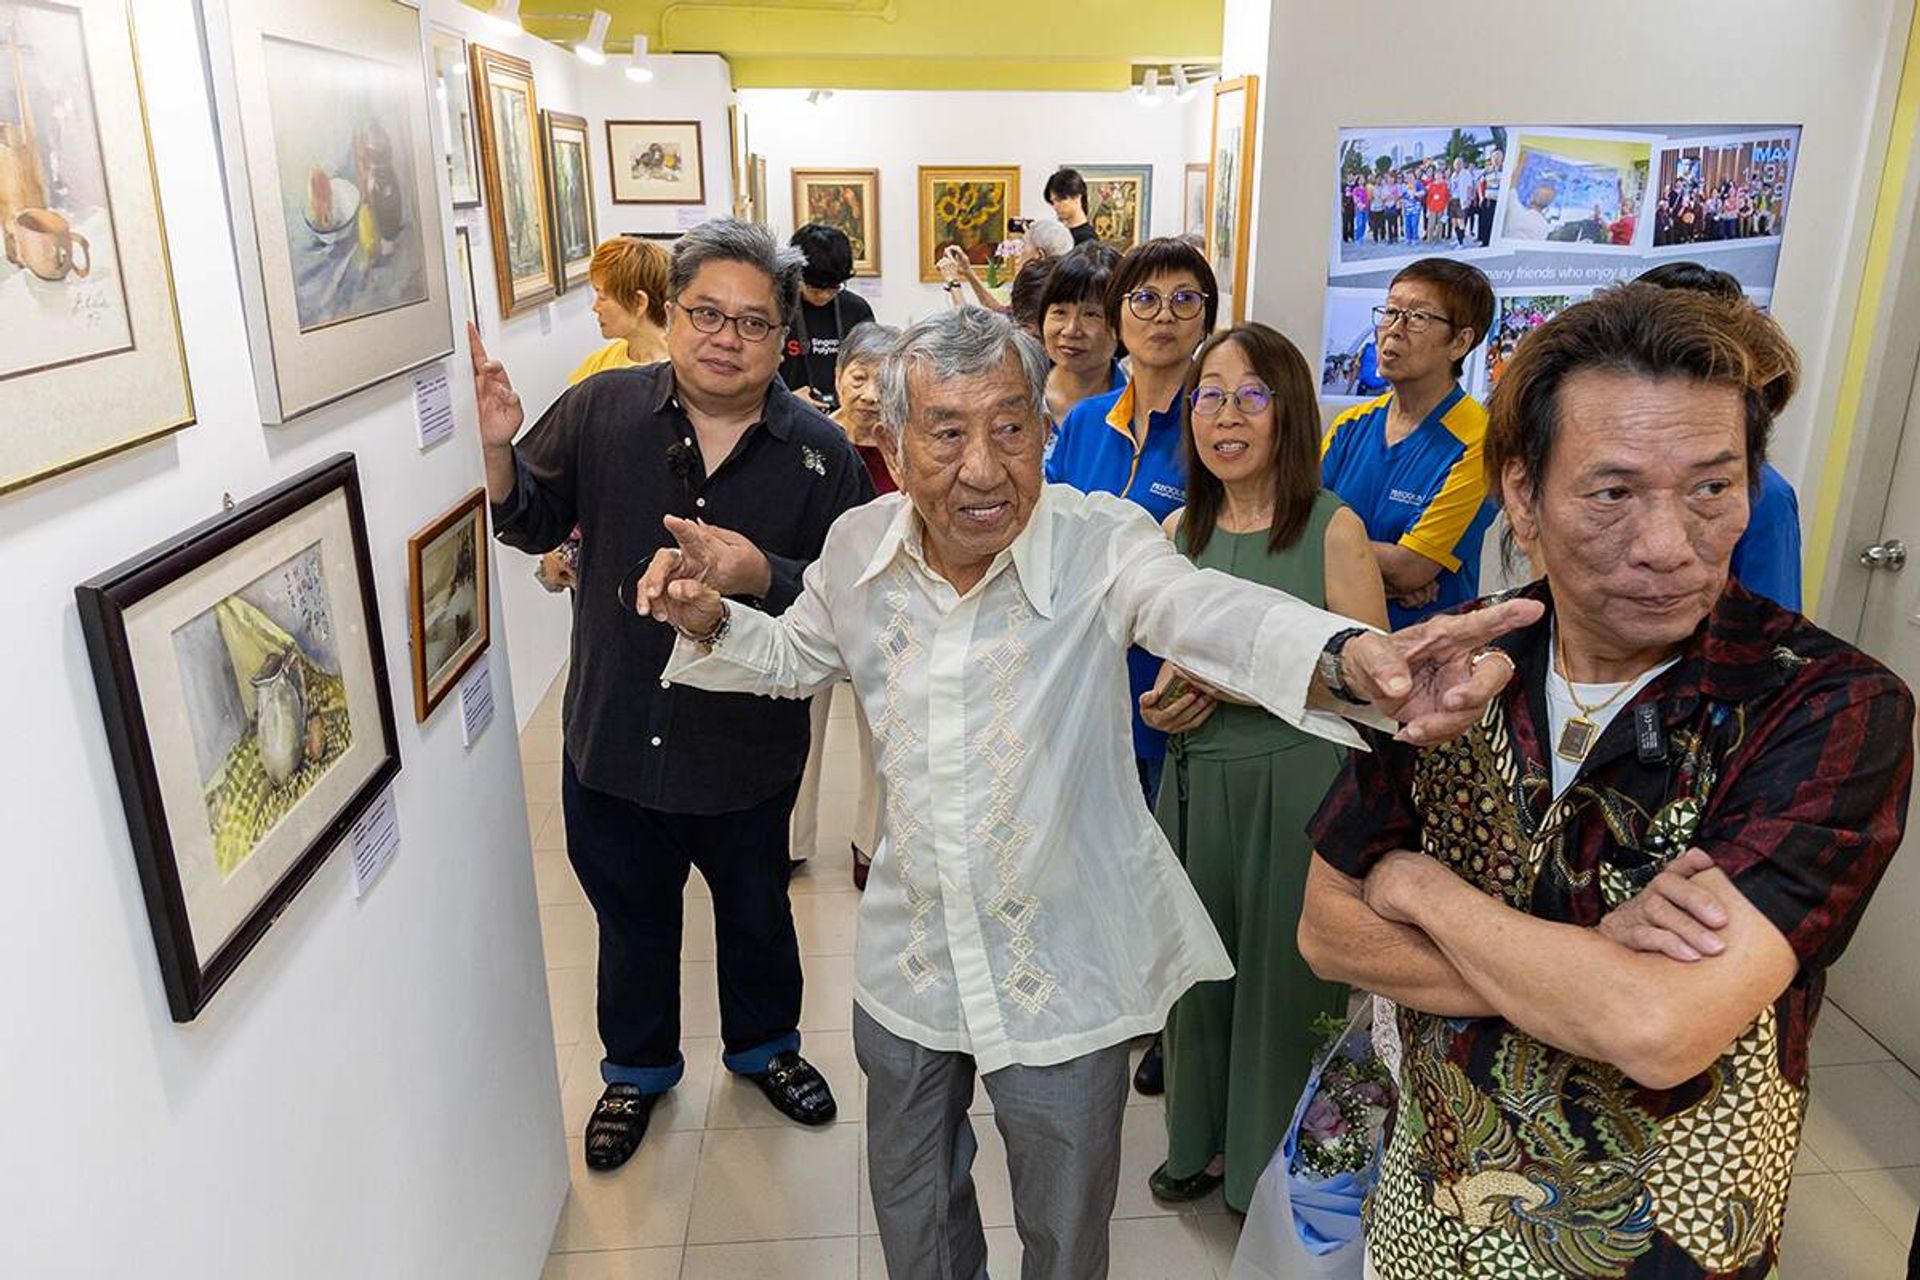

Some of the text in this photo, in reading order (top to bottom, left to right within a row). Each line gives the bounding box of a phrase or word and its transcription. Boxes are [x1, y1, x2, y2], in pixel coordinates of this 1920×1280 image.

[1516, 266, 1556, 280] friends
[1558, 267, 1584, 279] who
[1585, 266, 1616, 282] enjoy
